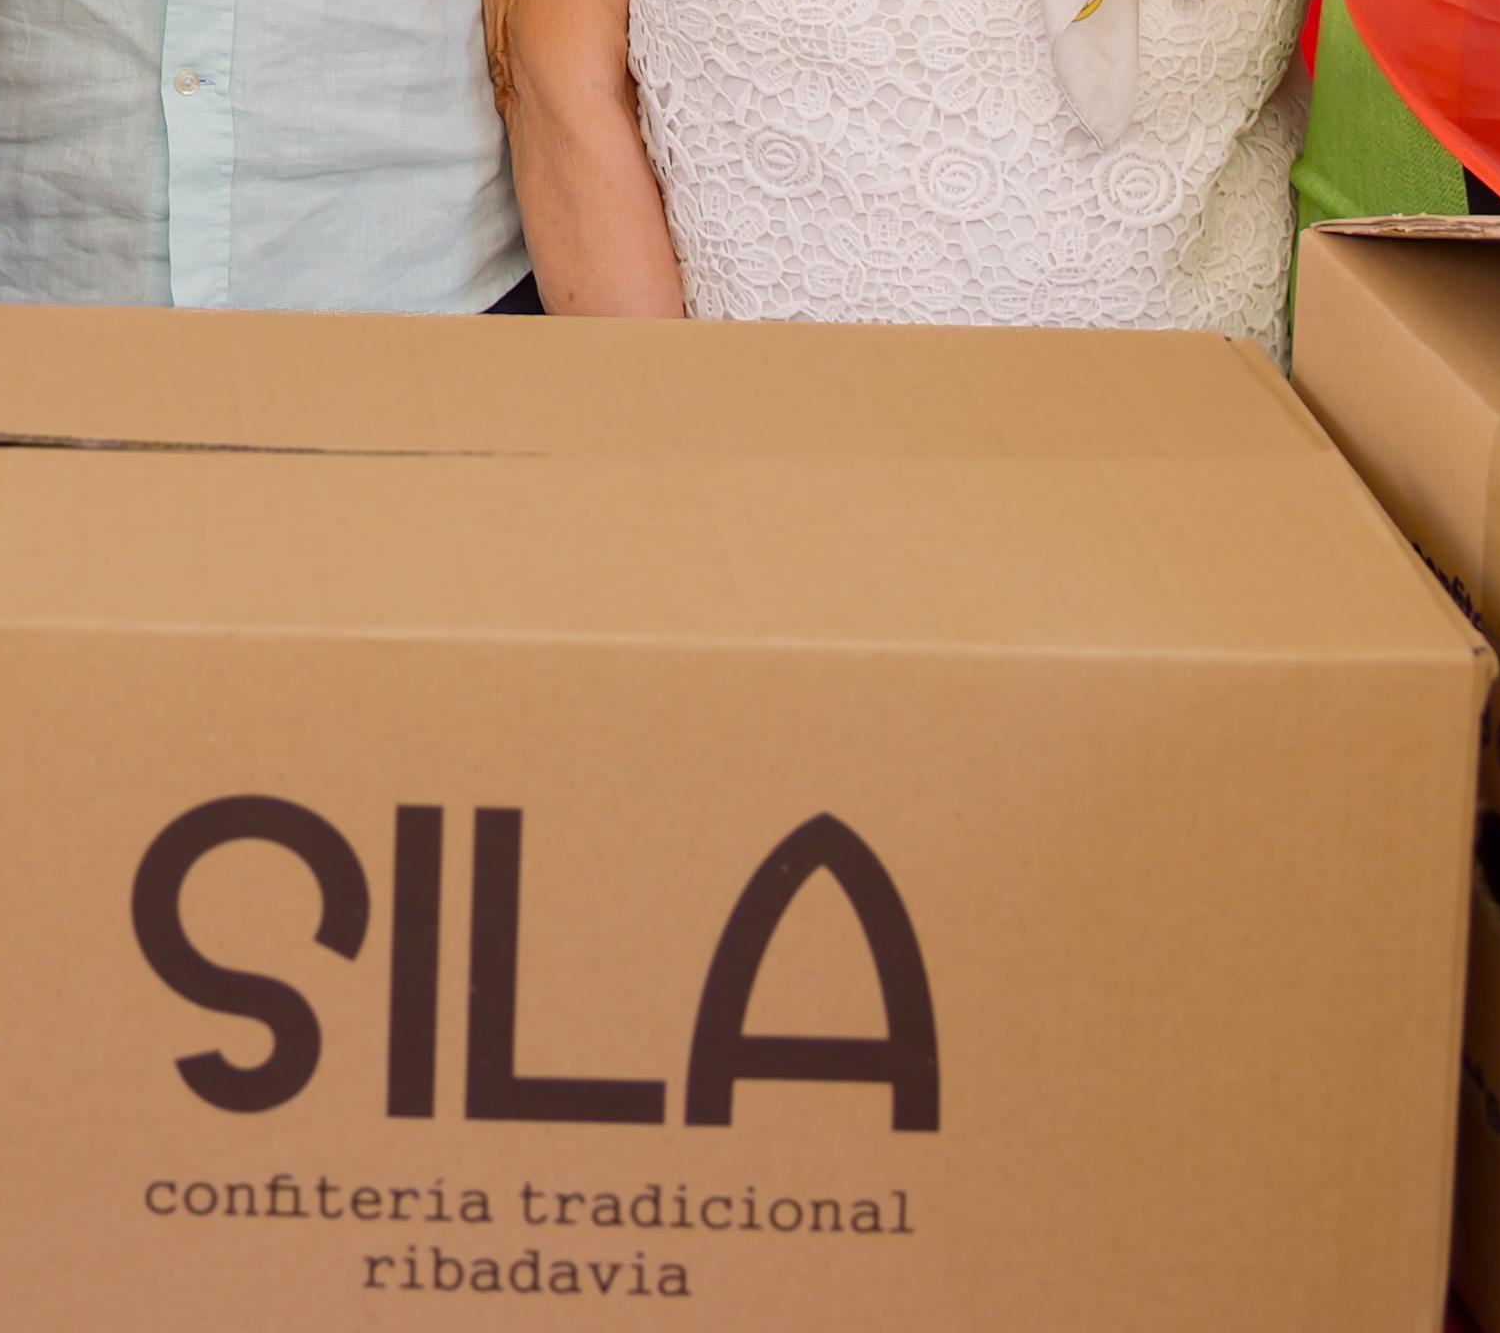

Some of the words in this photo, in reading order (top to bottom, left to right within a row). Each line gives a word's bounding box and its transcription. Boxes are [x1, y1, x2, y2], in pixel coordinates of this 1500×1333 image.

[130, 793, 941, 1133] SILA
[520, 1181, 916, 1235] tradicional
[362, 1246, 693, 1298] ribadavia
